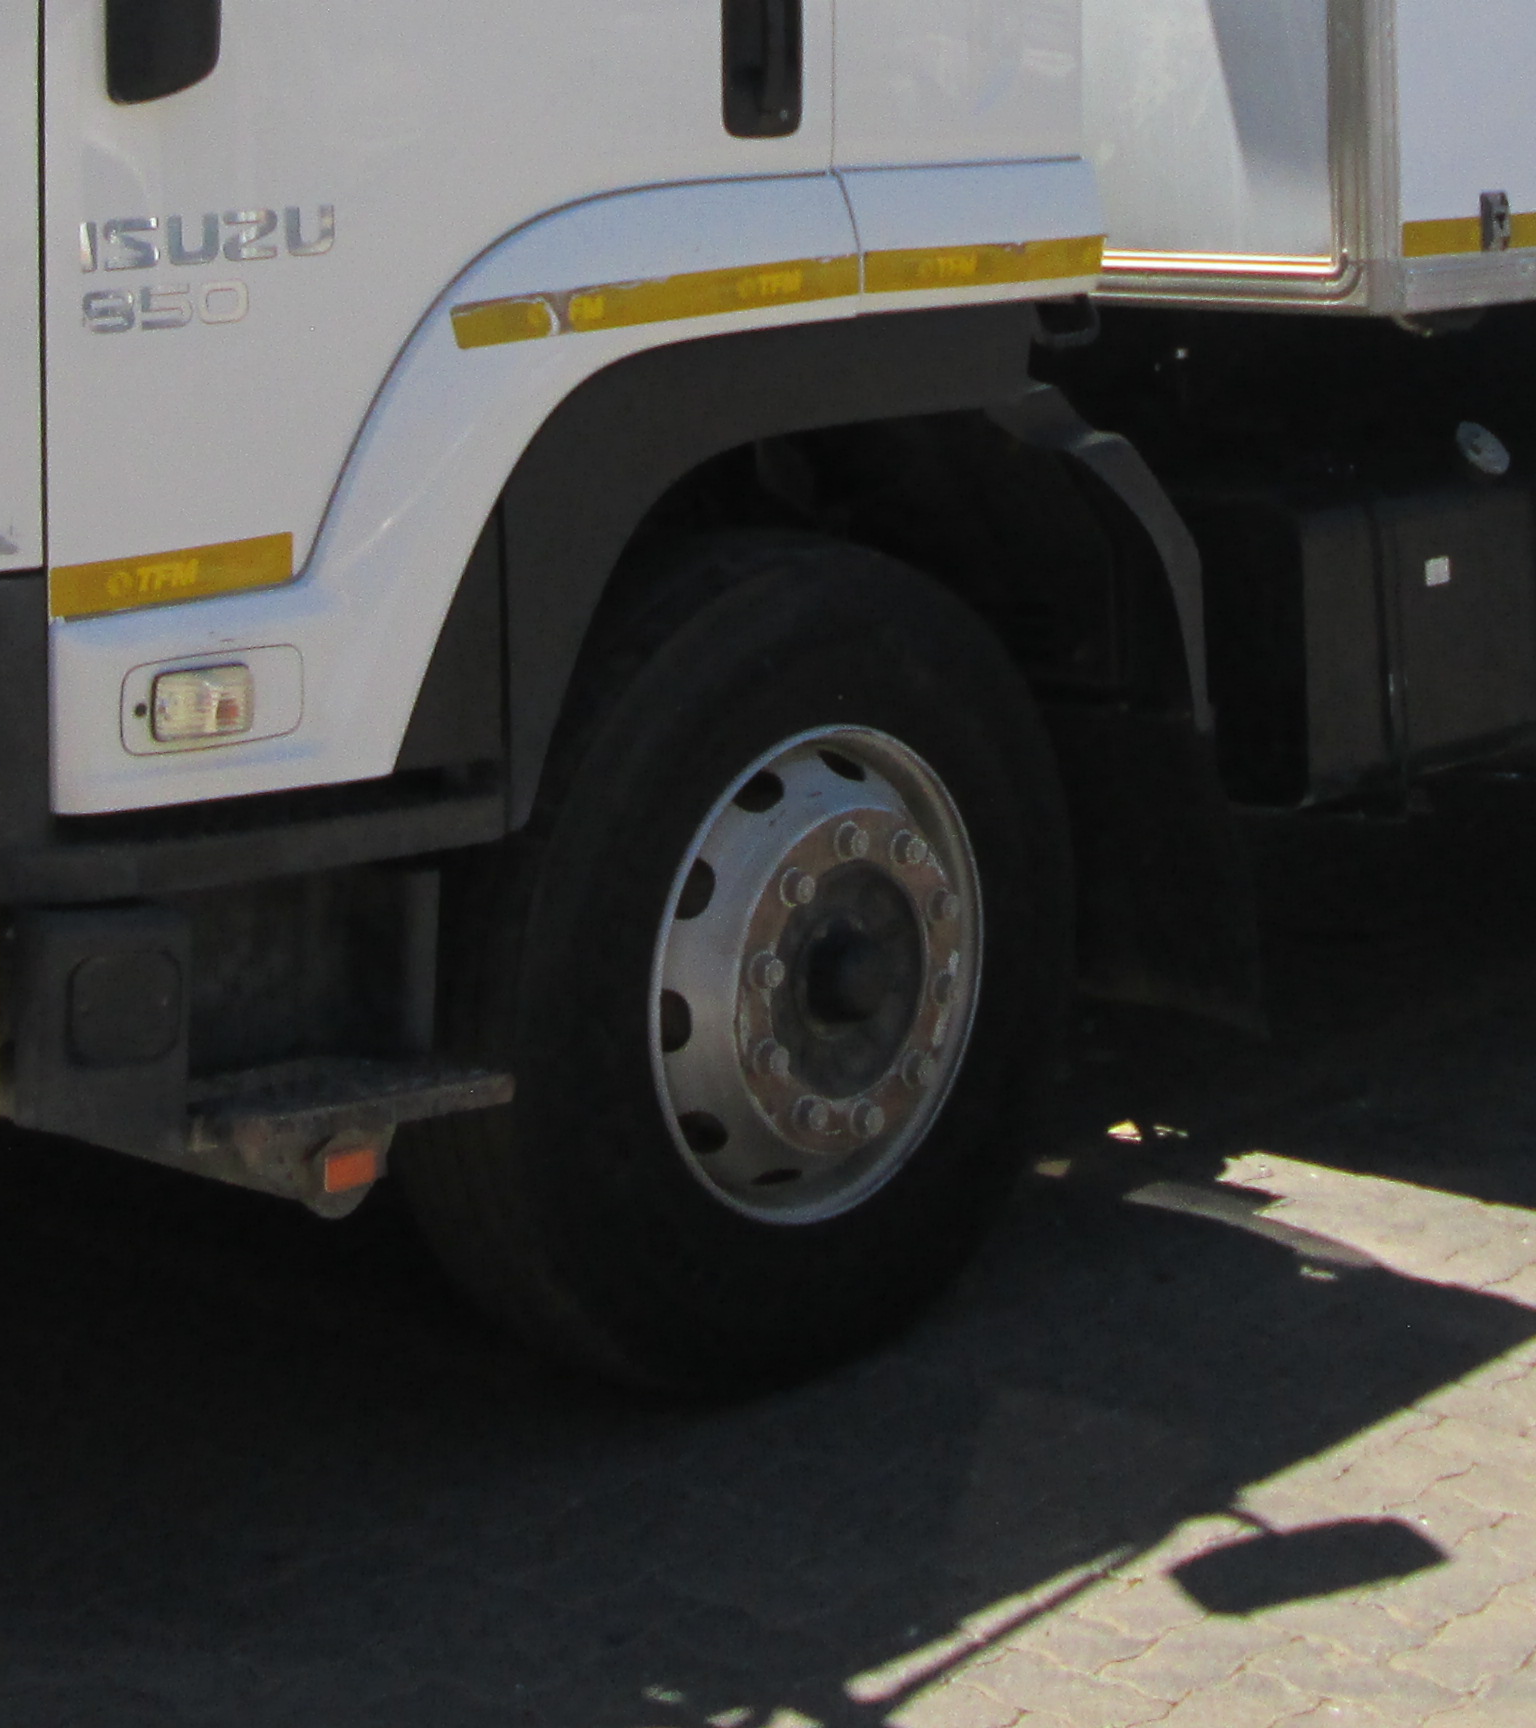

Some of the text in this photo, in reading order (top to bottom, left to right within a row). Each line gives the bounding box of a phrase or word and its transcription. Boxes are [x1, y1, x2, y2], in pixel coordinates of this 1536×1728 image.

[78, 203, 335, 273] ISUZU
[759, 268, 803, 294] TFM
[137, 558, 199, 593] TFM
